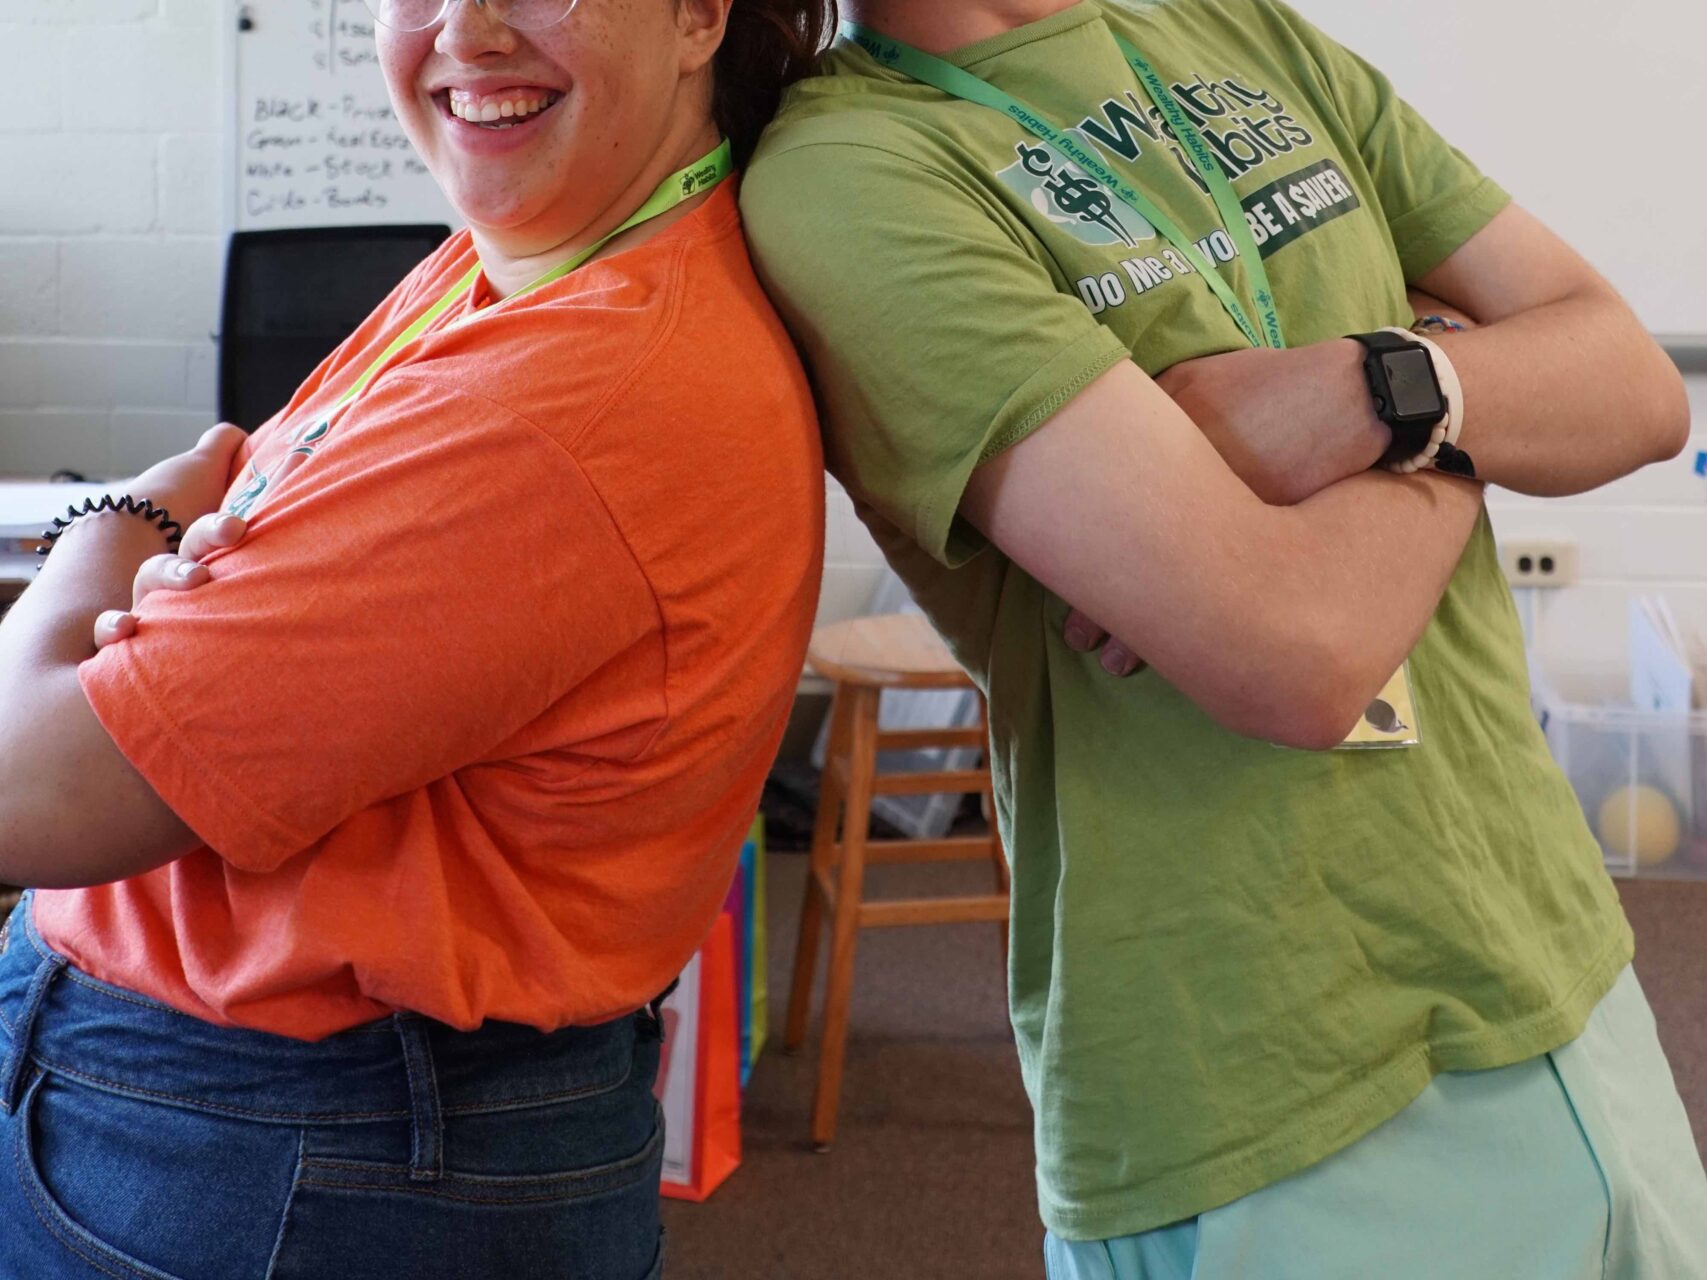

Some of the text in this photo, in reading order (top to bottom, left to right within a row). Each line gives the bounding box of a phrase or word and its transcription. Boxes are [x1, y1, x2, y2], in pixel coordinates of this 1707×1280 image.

[1008, 104, 1119, 188] Wealthy Habits
[1145, 73, 1214, 172] Wealthy Habits
[1244, 168, 1353, 247] BE A $AVER
